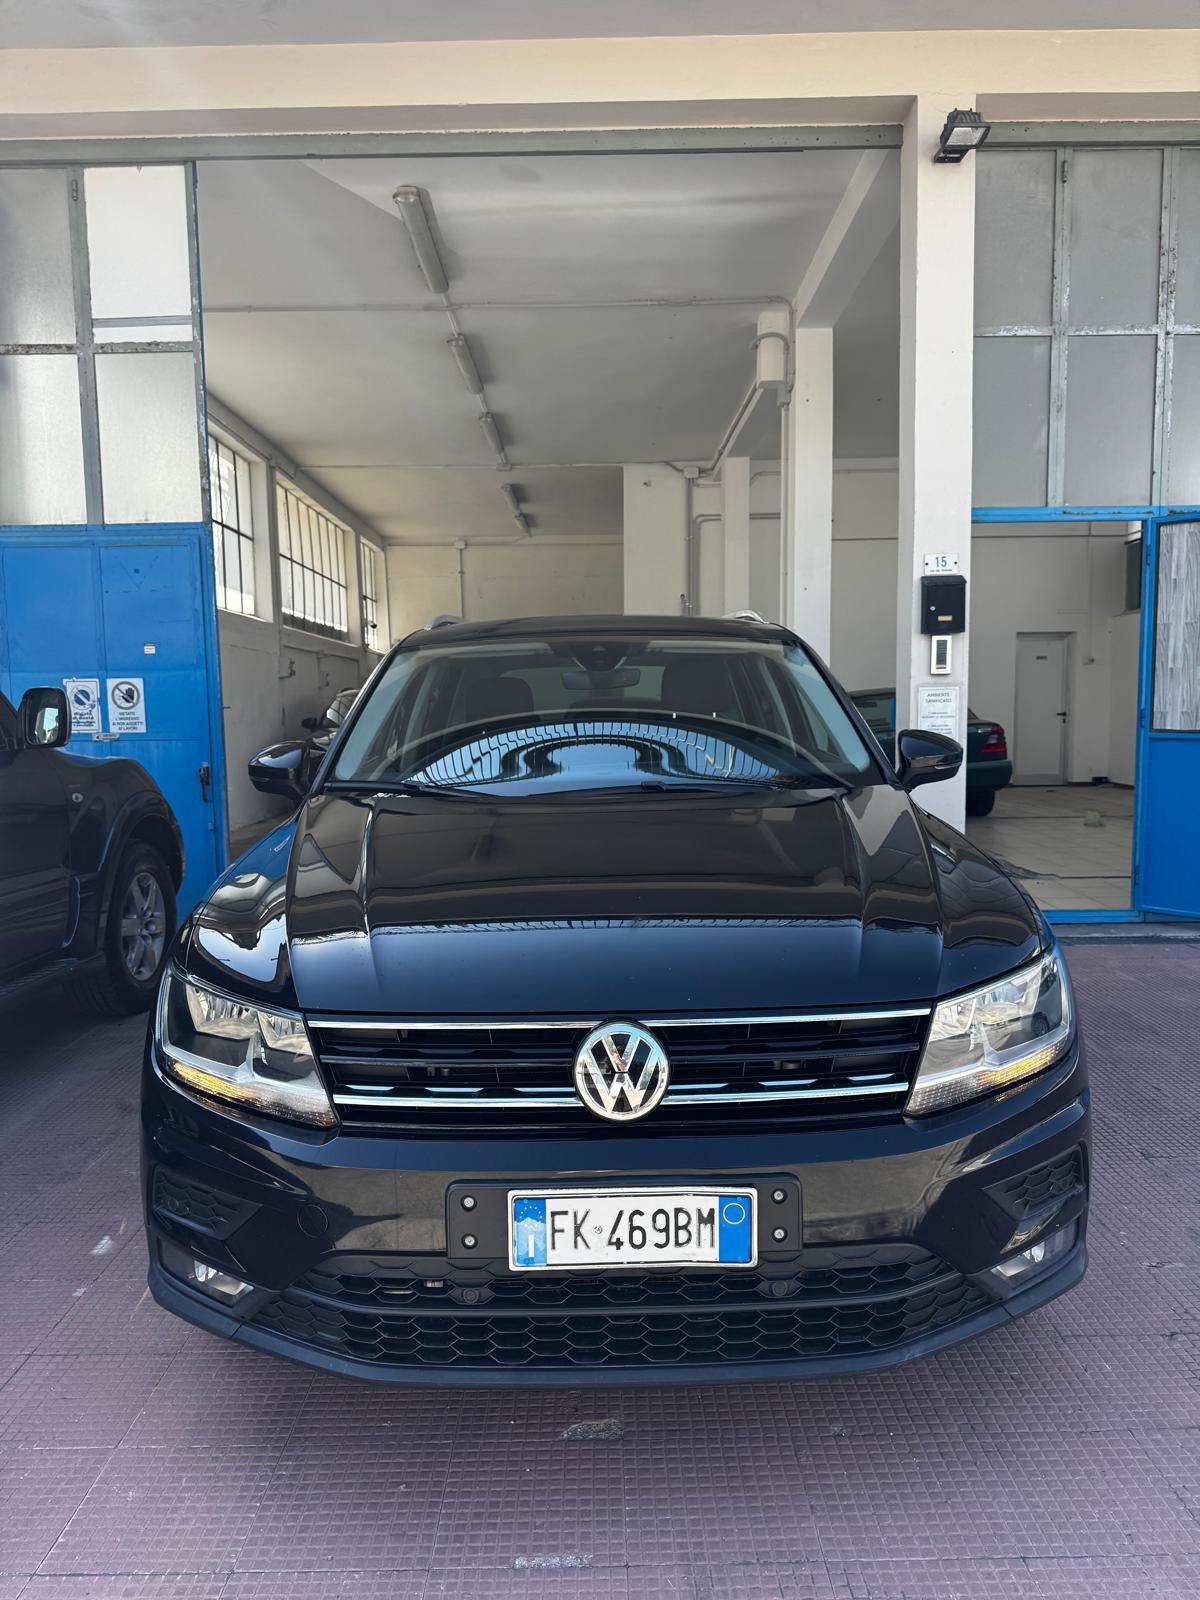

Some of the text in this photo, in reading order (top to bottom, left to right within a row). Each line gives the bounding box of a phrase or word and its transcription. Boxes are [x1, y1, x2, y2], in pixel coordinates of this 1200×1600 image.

[935, 556, 947, 568] 15
[550, 1208, 590, 1251] FK
[607, 1206, 716, 1251] 469BM
